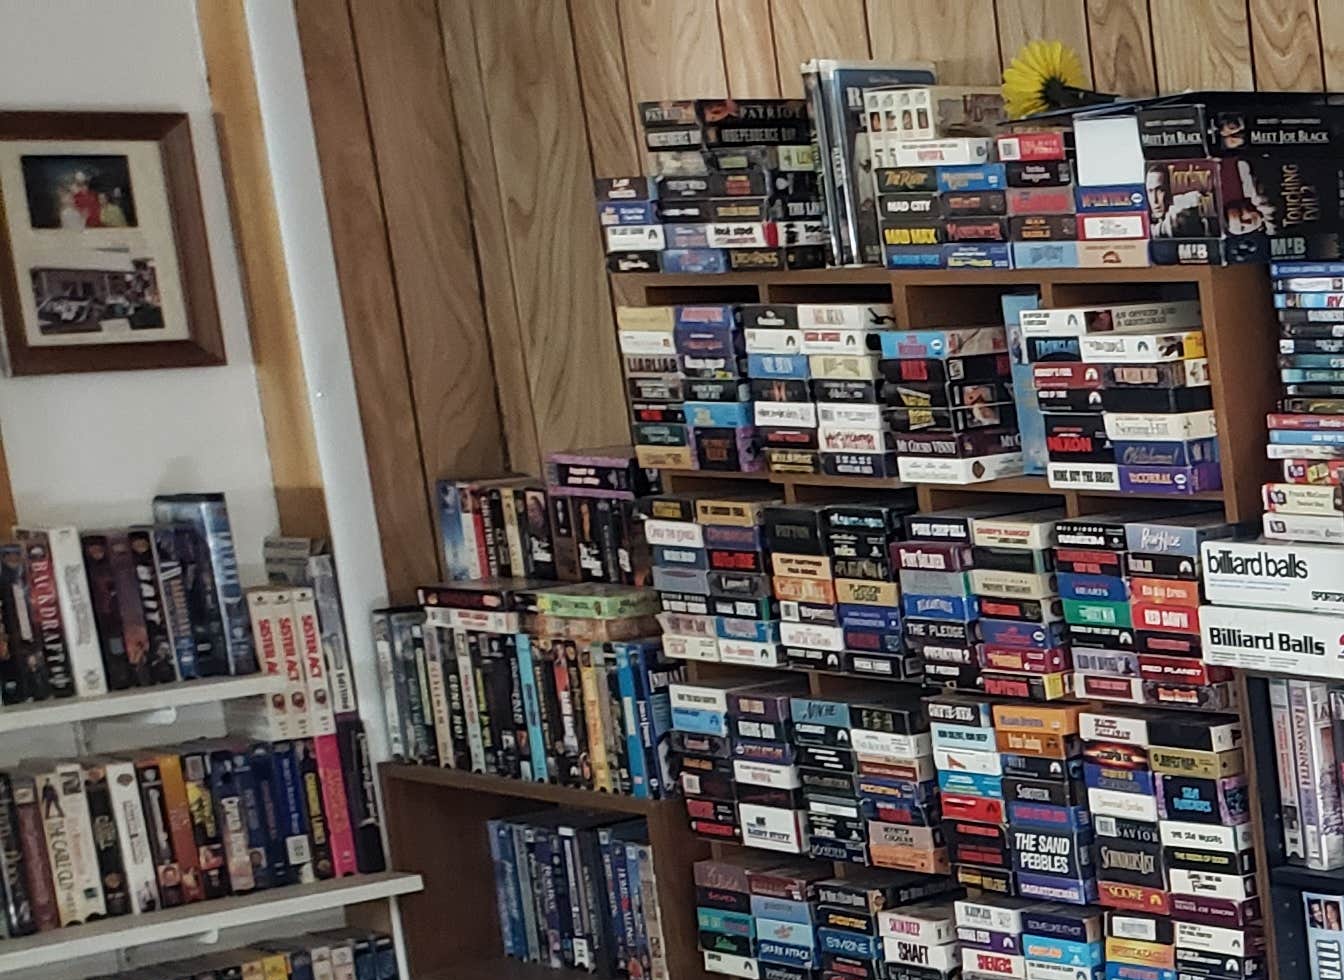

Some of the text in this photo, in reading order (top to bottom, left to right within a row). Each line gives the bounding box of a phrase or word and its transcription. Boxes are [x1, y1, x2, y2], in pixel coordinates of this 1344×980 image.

[1250, 130, 1329, 144] MEET BLACK
[906, 200, 931, 213] CITY
[1207, 550, 1308, 581] billiard balls
[907, 623, 966, 639] THE PLEDGE
[1209, 627, 1325, 656] Billiard Balls
[1164, 667, 1201, 676] PLANET
[1014, 833, 1070, 856] THE SAND
[1020, 853, 1070, 874] PEBBLES
[898, 942, 929, 964] SHAFT
